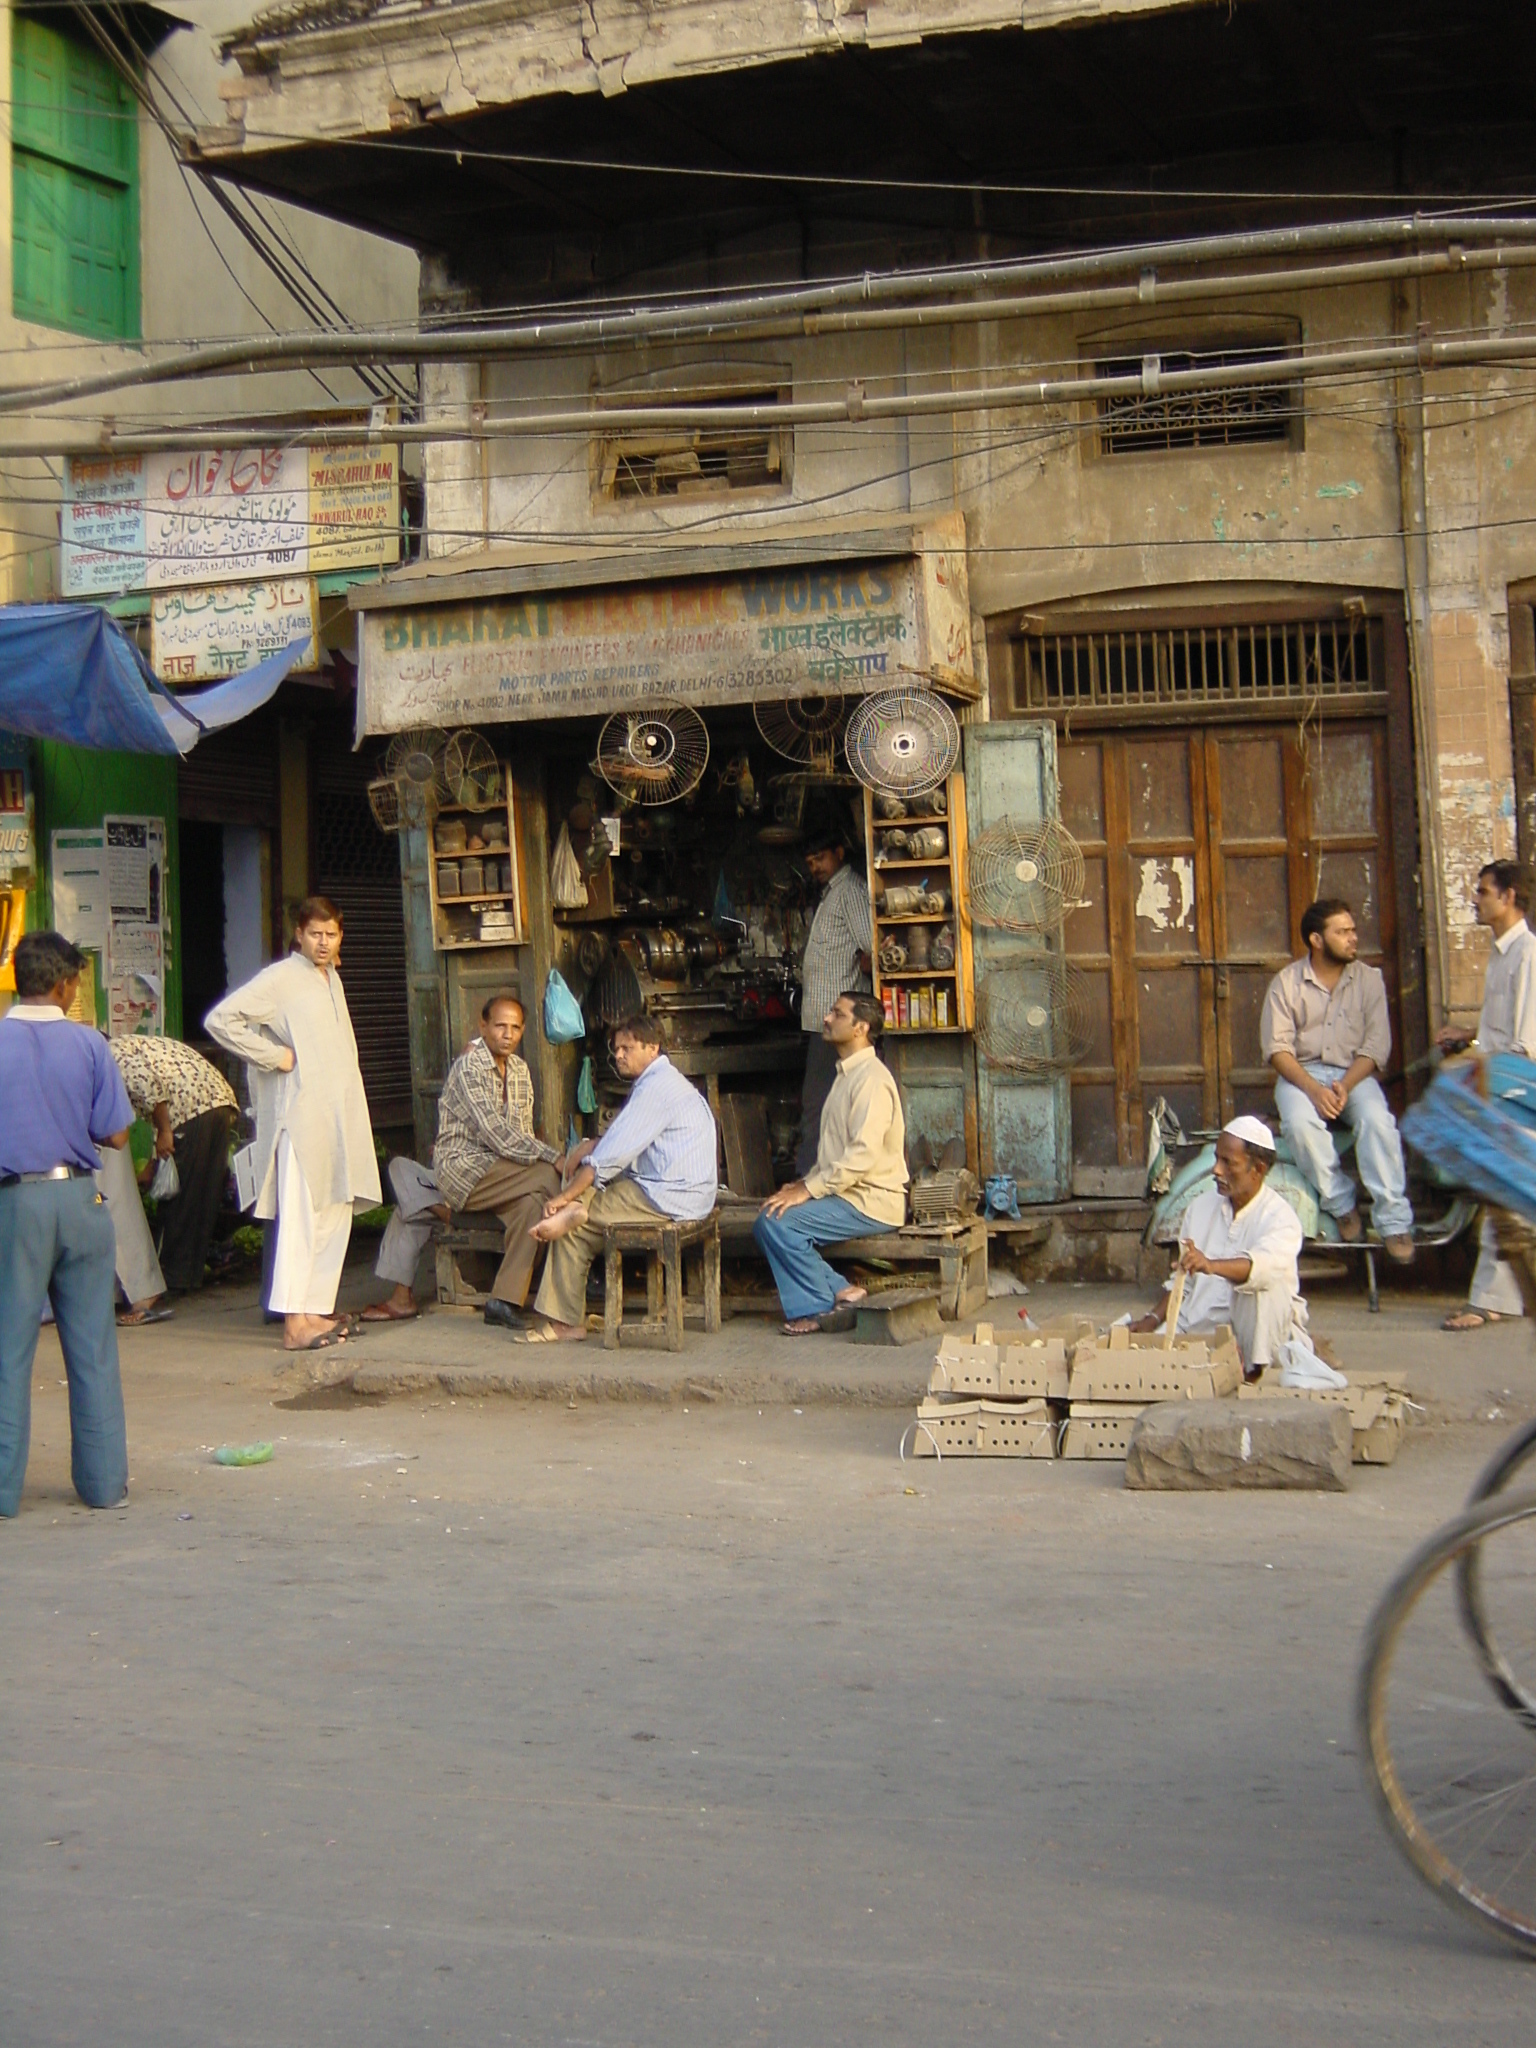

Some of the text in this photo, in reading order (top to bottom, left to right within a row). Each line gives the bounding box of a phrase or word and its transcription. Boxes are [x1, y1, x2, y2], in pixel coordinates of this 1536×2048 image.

[374, 462, 392, 480] HAQ
[383, 599, 551, 652] BHARAT
[741, 568, 895, 618] WORKS
[500, 664, 660, 691] MOTOR PARTS REPAIRERS
[437, 699, 460, 713] SHOP
[508, 692, 535, 706] NEAR
[538, 688, 568, 704] JAMA
[571, 685, 608, 701] MASJID
[612, 683, 638, 697] URDU
